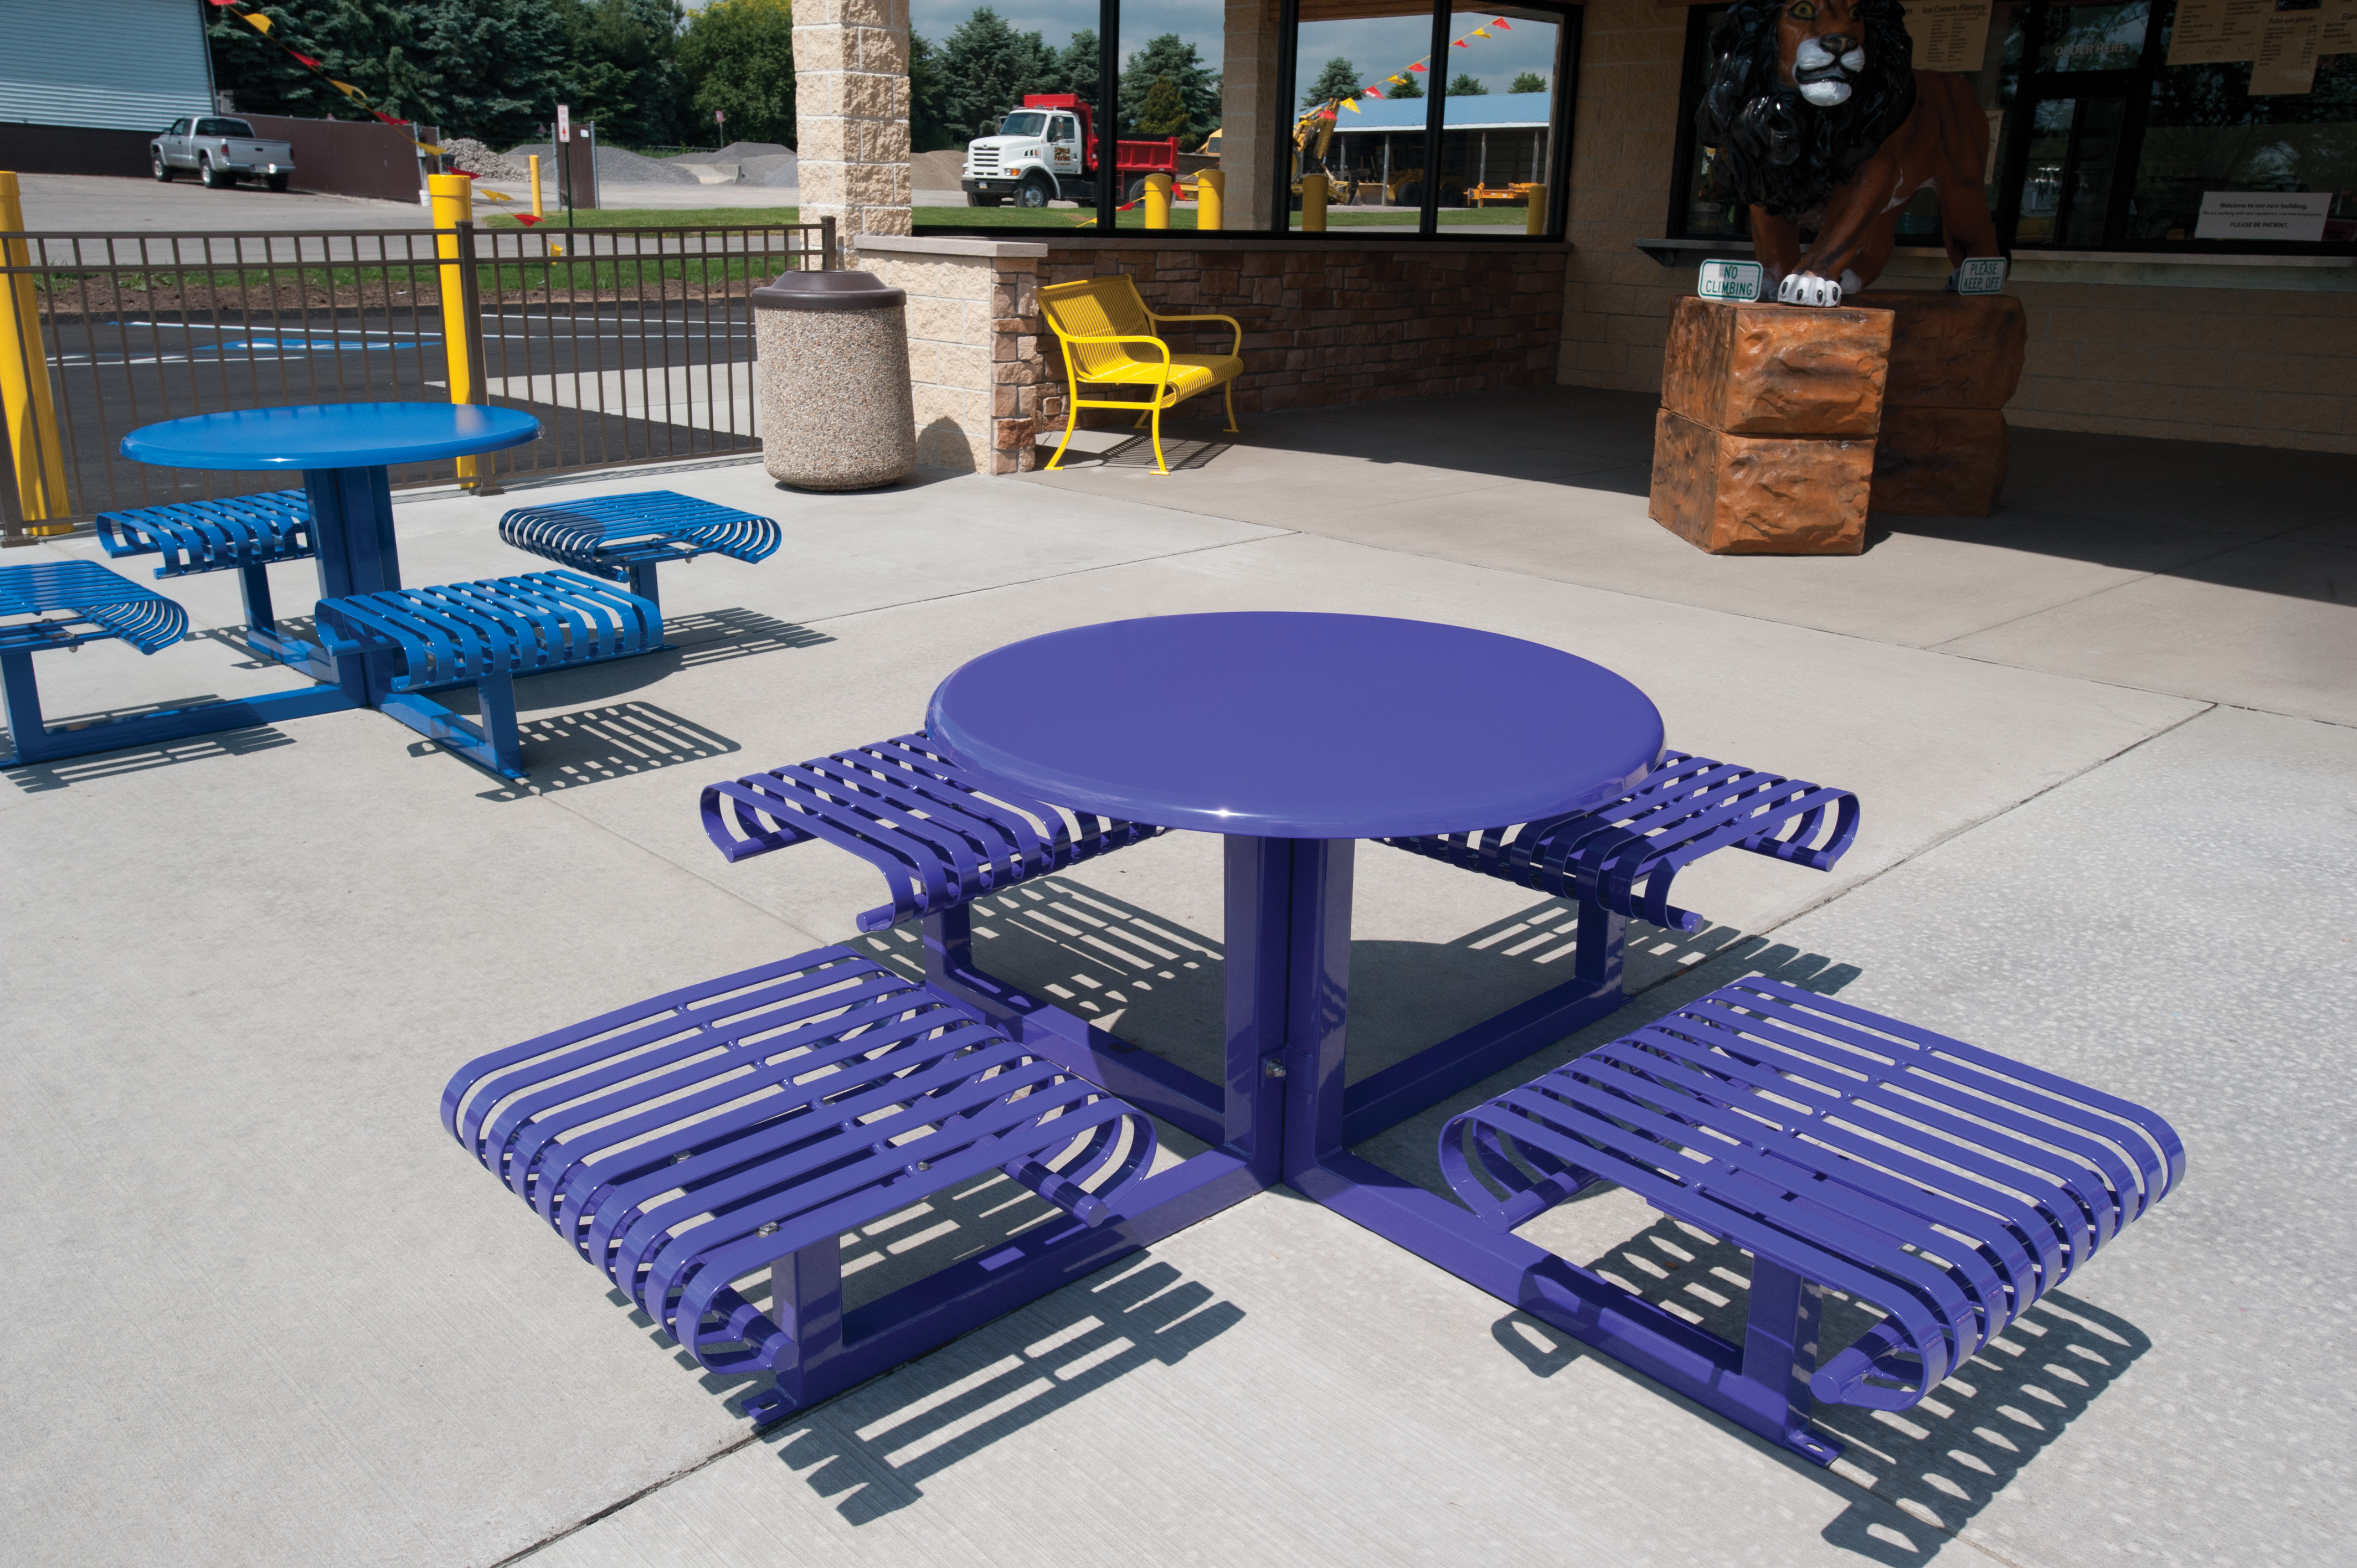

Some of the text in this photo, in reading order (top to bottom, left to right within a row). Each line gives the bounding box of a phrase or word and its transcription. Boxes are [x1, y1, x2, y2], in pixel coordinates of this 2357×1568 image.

[2096, 42, 2127, 54] HERE
[1724, 266, 1738, 279] NO
[1970, 263, 1998, 275] PLEASE
[1706, 281, 1753, 296] CLIMBING
[1963, 277, 2000, 290] KEEP OFF
